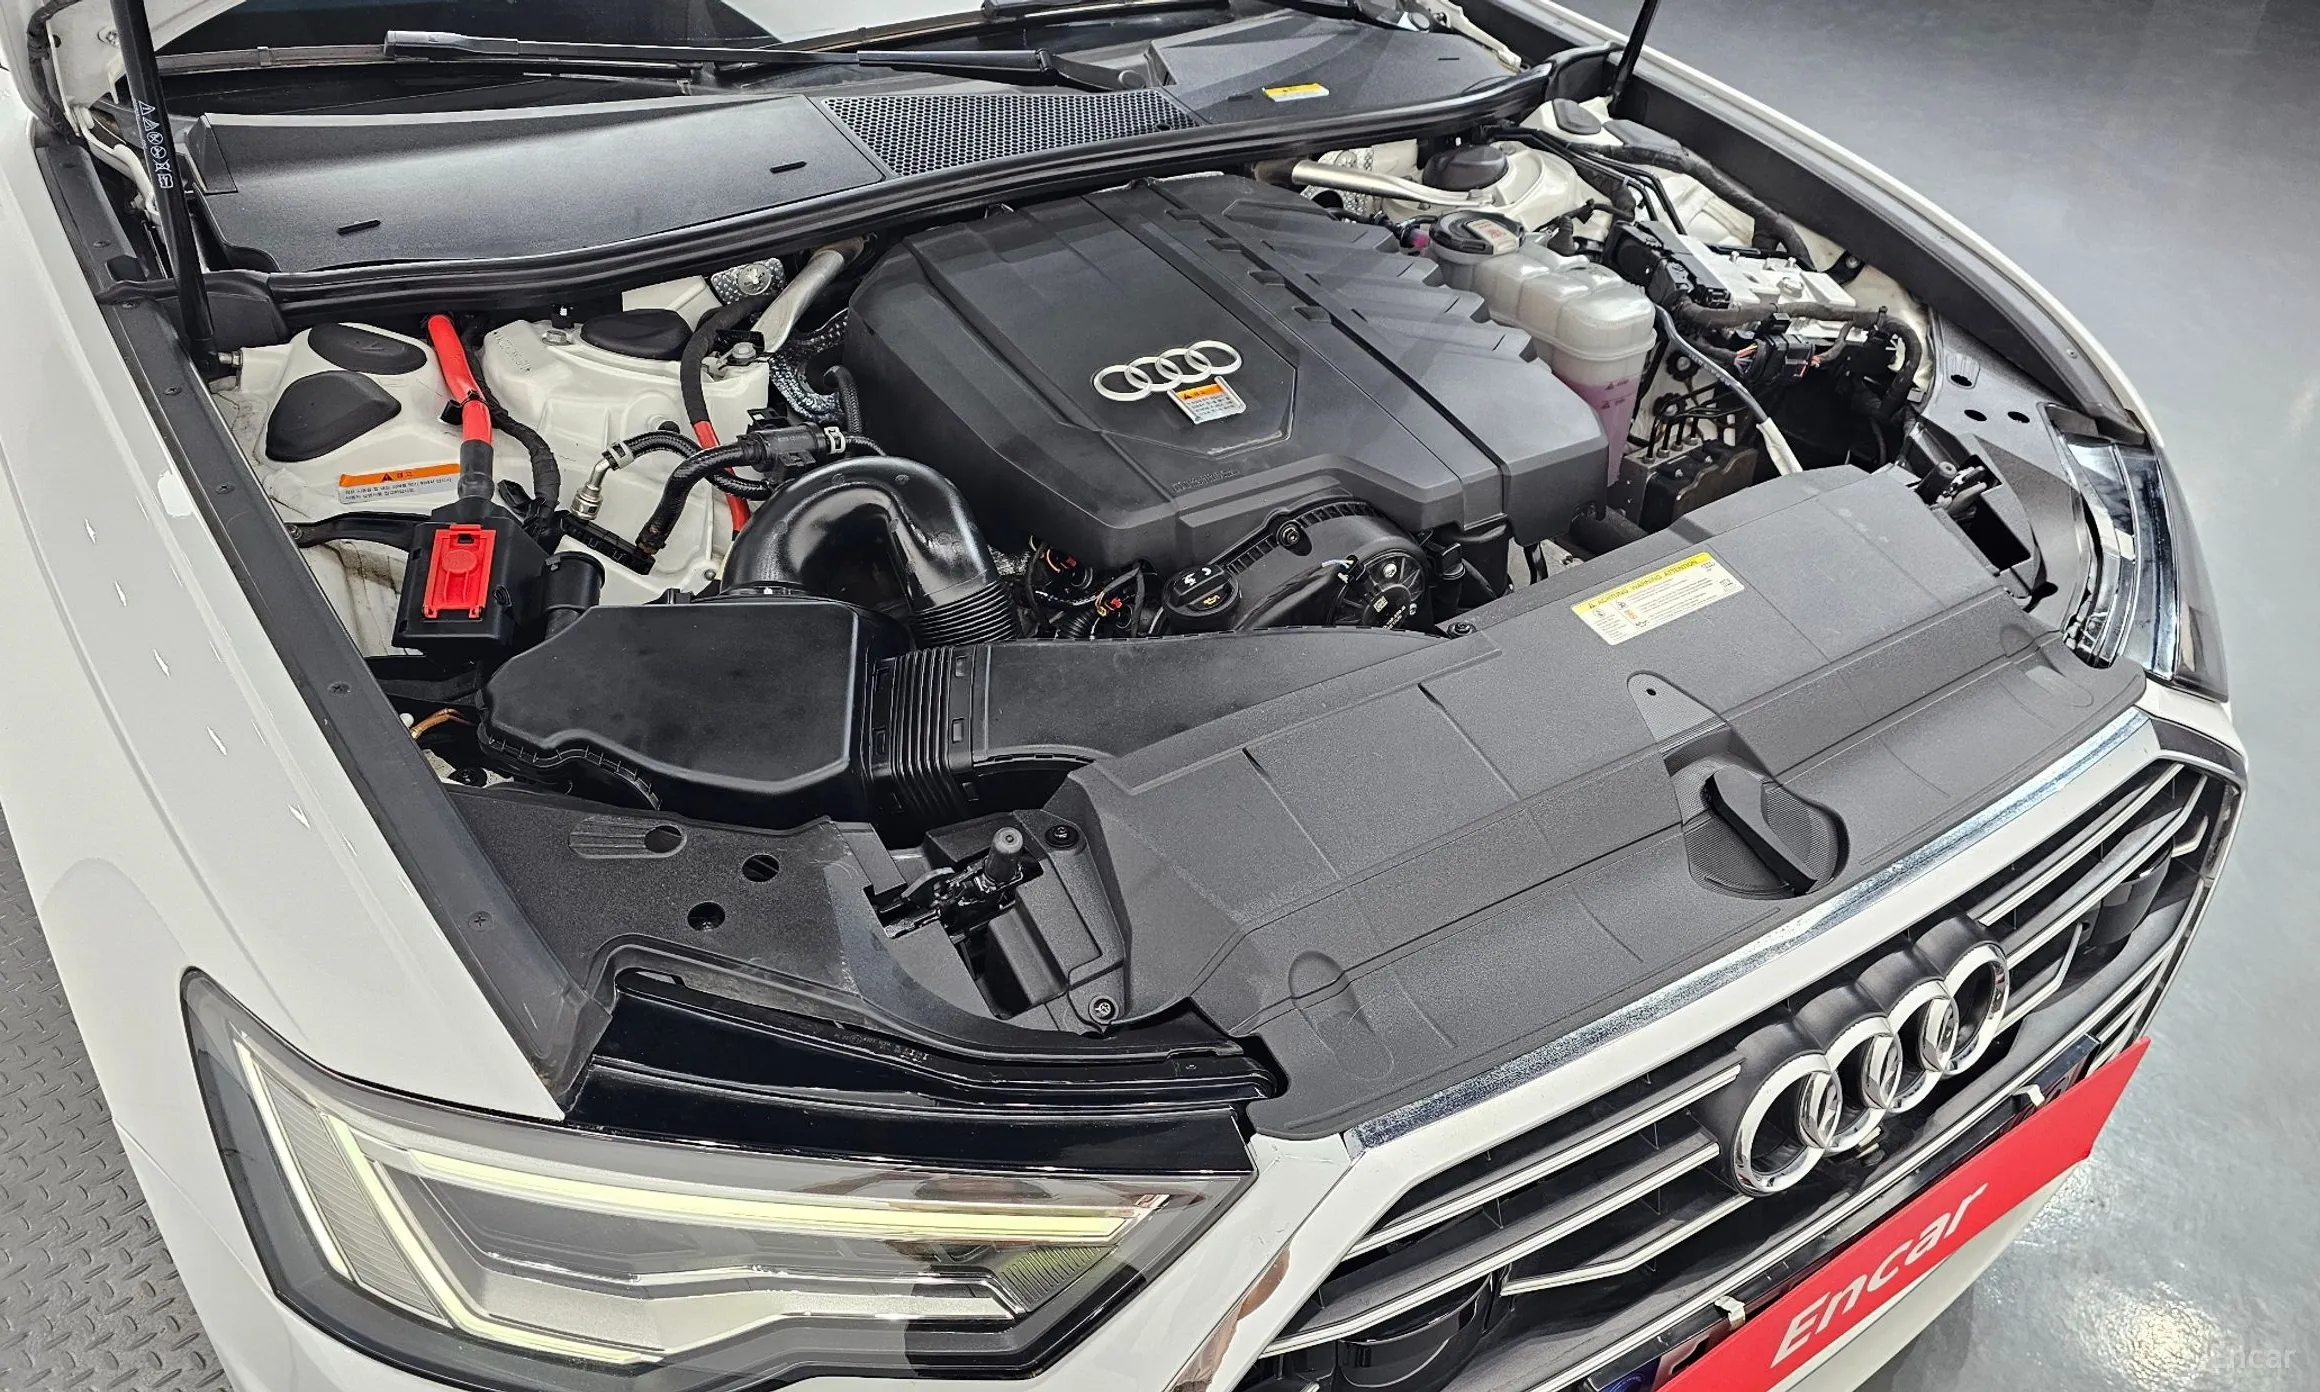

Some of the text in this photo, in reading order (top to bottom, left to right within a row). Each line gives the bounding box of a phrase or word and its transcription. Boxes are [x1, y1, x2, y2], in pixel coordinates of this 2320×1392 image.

[1598, 588, 1629, 605] ACHTUNG
[1632, 574, 1662, 590] WARNING
[1664, 560, 1698, 577] ATTENTION
[1770, 1182, 1989, 1369] Encar
